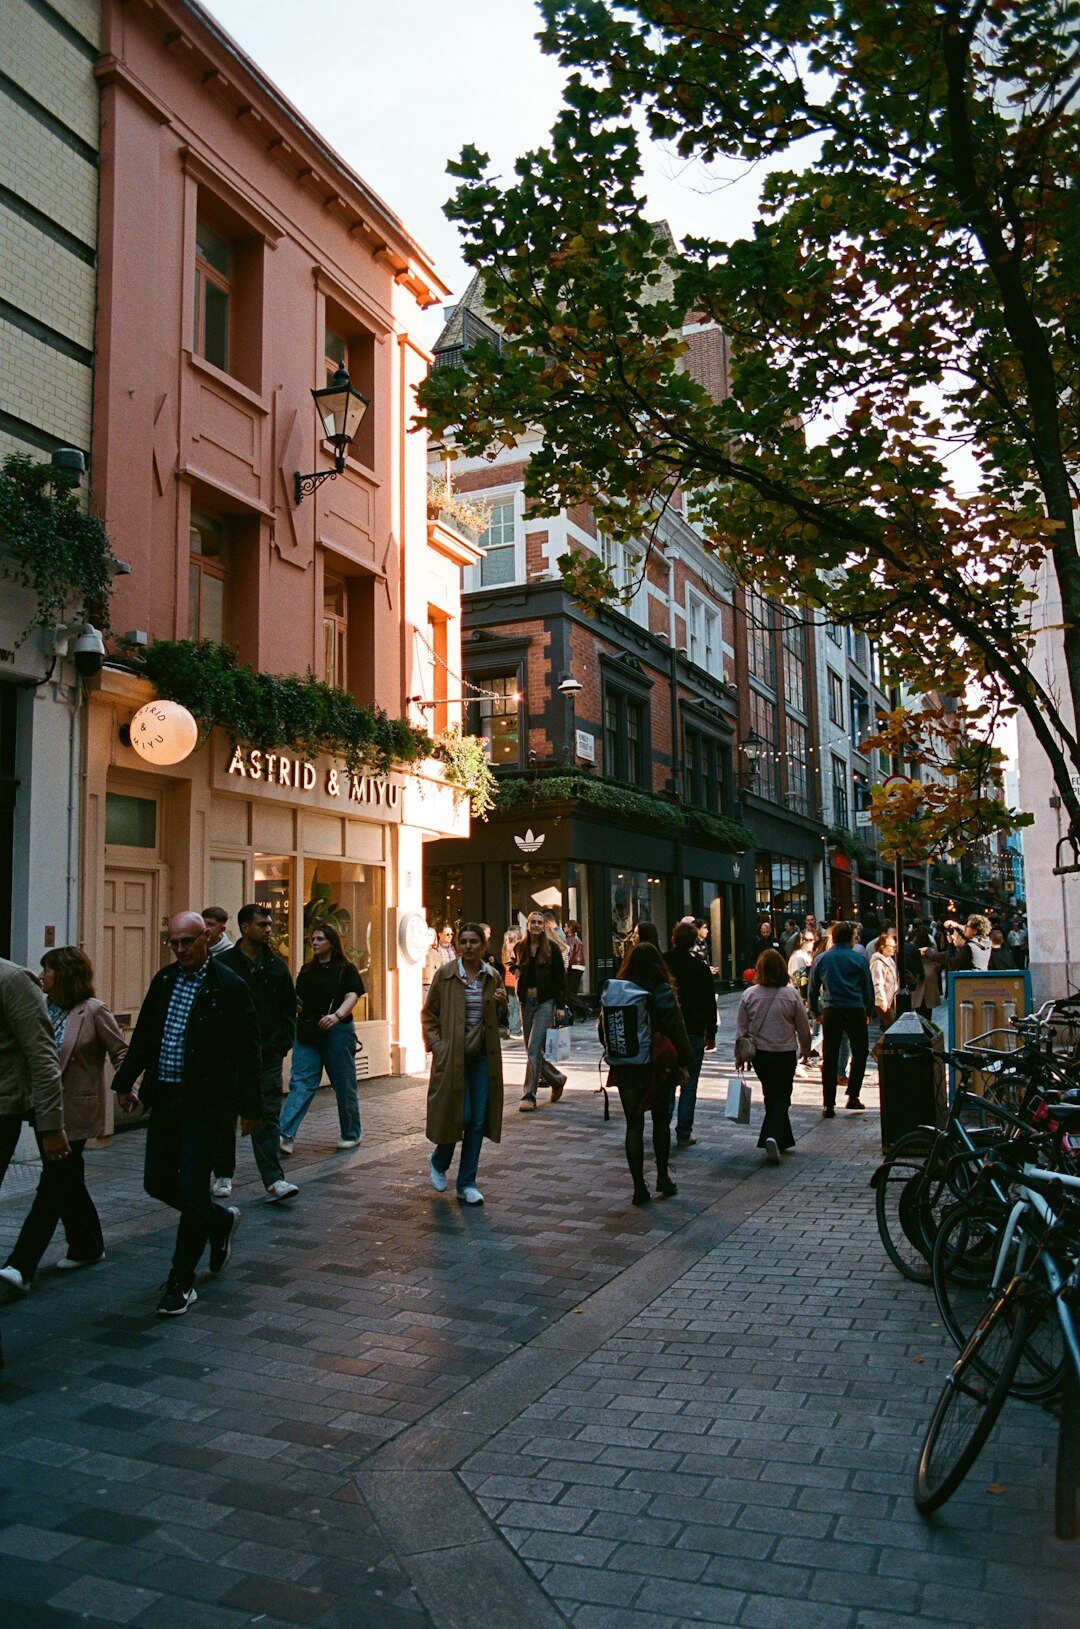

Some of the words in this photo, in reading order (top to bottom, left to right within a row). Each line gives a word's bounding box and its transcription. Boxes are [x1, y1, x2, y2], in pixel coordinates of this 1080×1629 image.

[133, 706, 165, 721] ASTRID
[140, 722, 147, 732] &
[133, 734, 164, 749] MIYU
[228, 744, 316, 790] ASTRID
[327, 769, 341, 797] &
[349, 775, 399, 808] MIYU
[614, 1010, 627, 1055] EXPRESS
